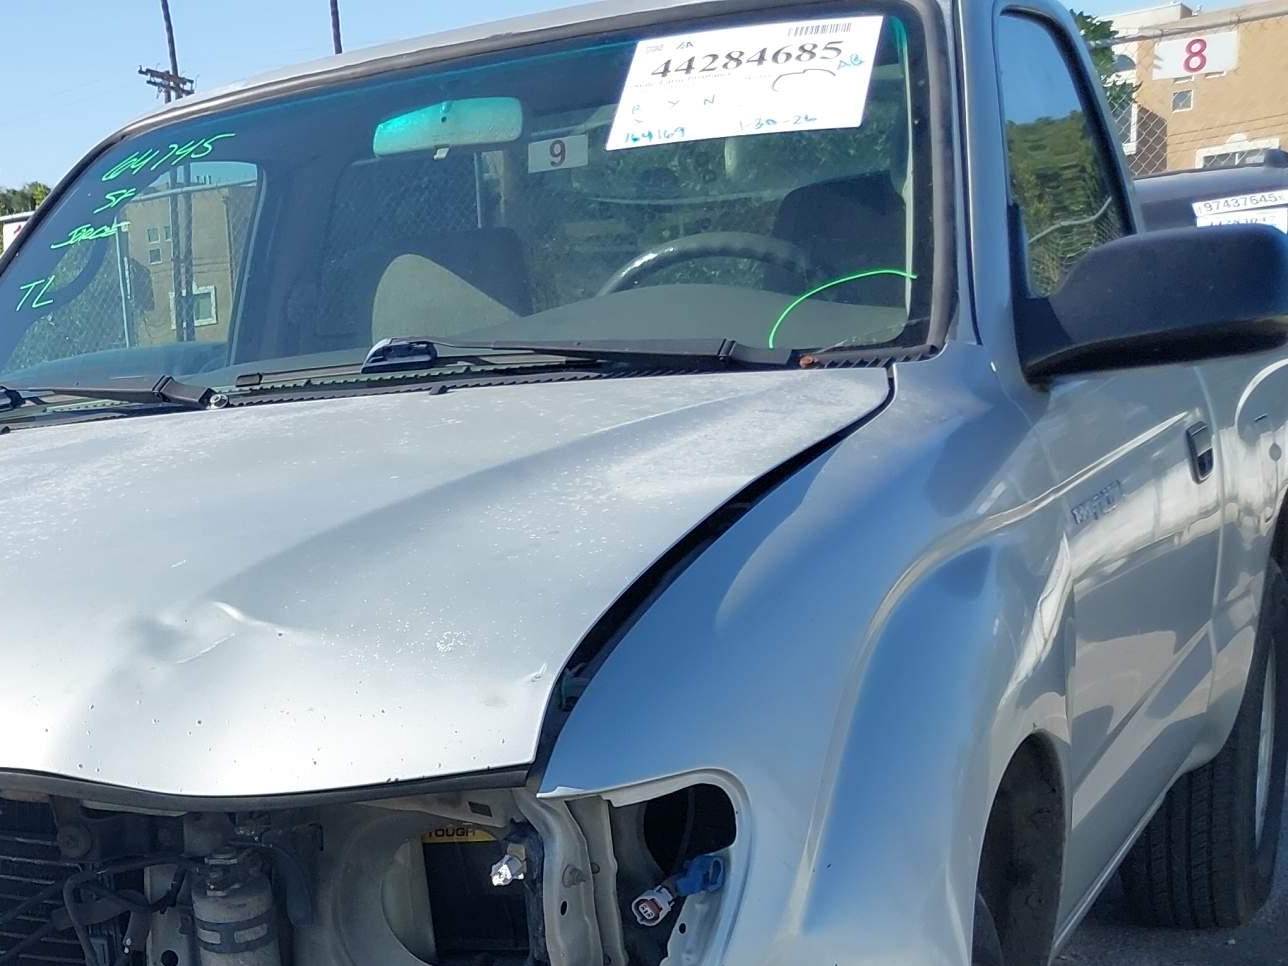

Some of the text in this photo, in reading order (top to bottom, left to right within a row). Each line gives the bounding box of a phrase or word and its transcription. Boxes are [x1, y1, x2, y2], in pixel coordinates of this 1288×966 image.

[650, 40, 844, 78] 44284685
[1183, 38, 1208, 73] 8
[549, 140, 566, 167] 9
